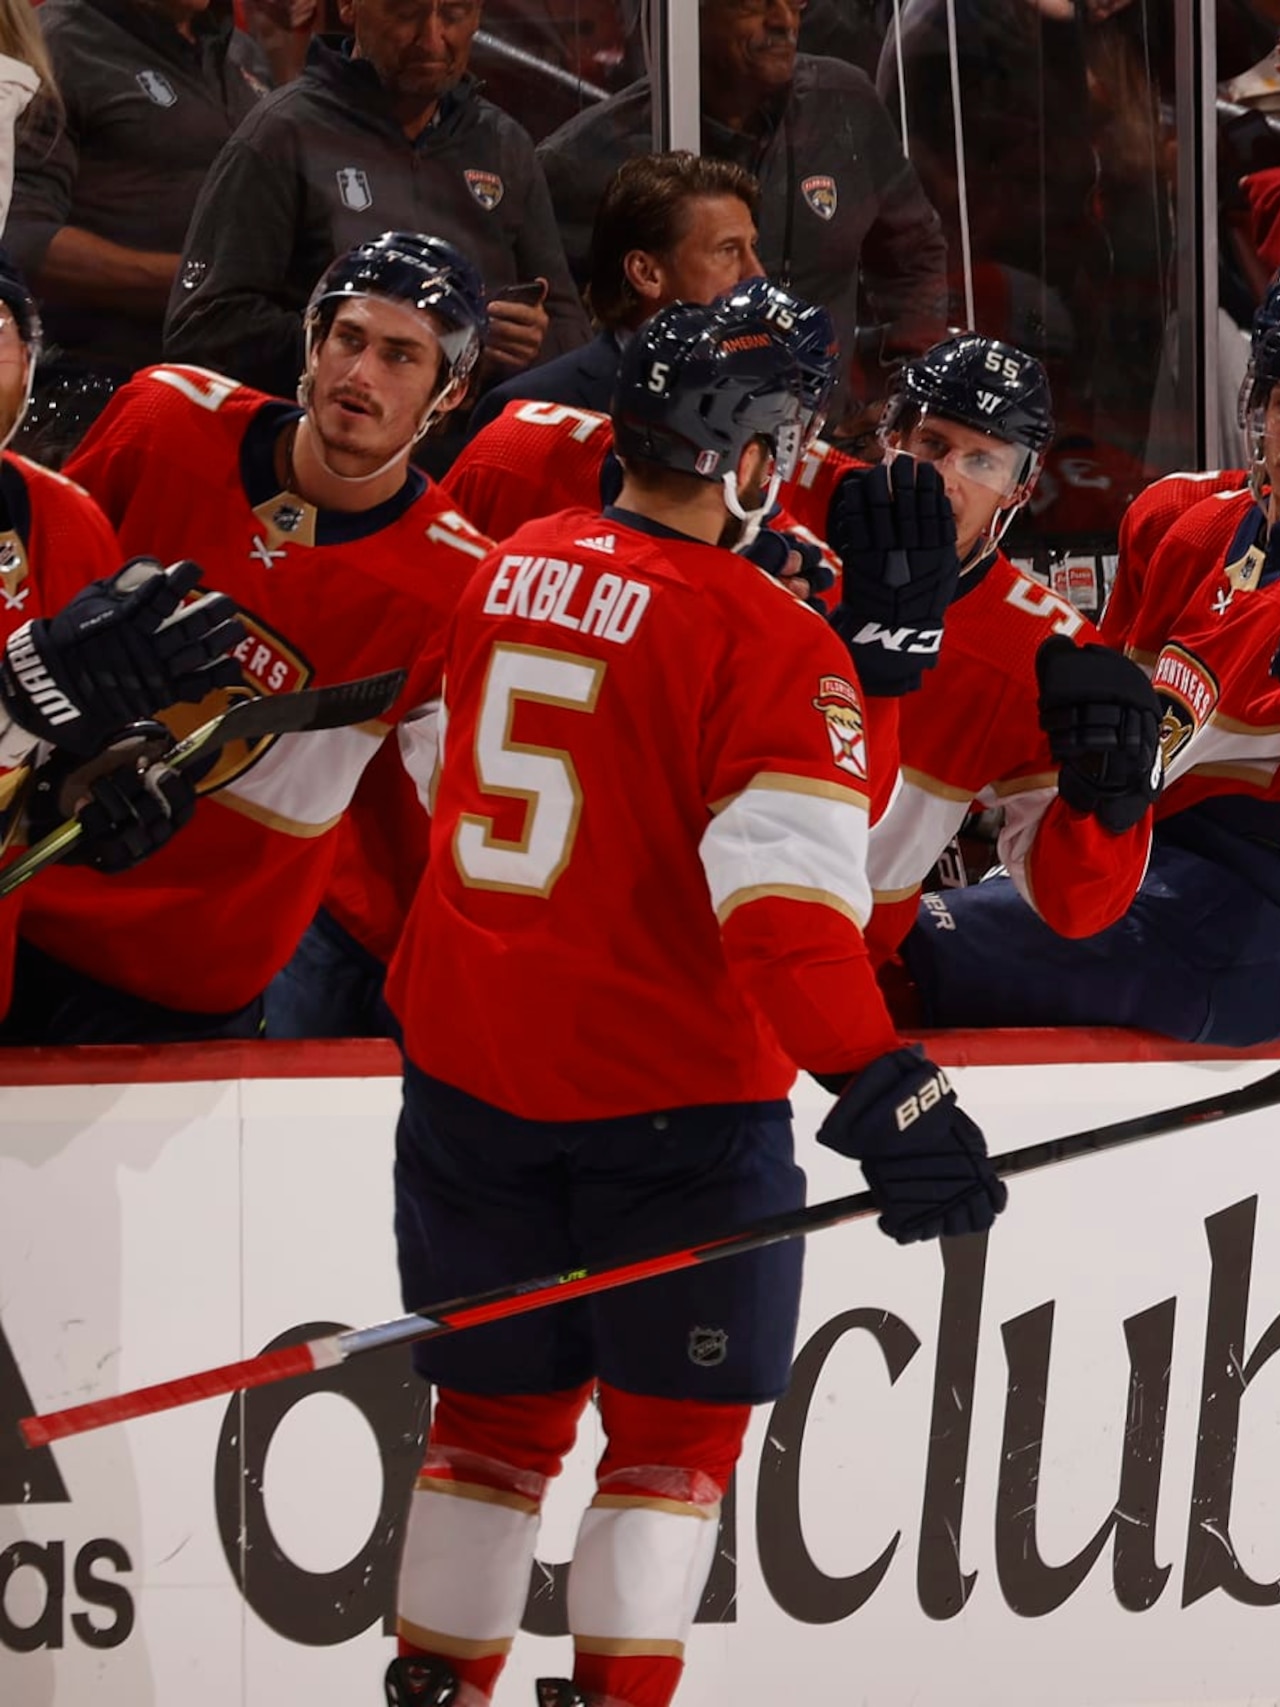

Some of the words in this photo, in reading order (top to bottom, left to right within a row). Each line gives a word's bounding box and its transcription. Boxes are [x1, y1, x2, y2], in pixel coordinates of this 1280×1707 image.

[648, 361, 670, 393] 5
[984, 350, 1020, 380] 55
[482, 555, 651, 644] EKBLAD
[1155, 656, 1211, 719] PANTHERS
[453, 640, 608, 900] 5
